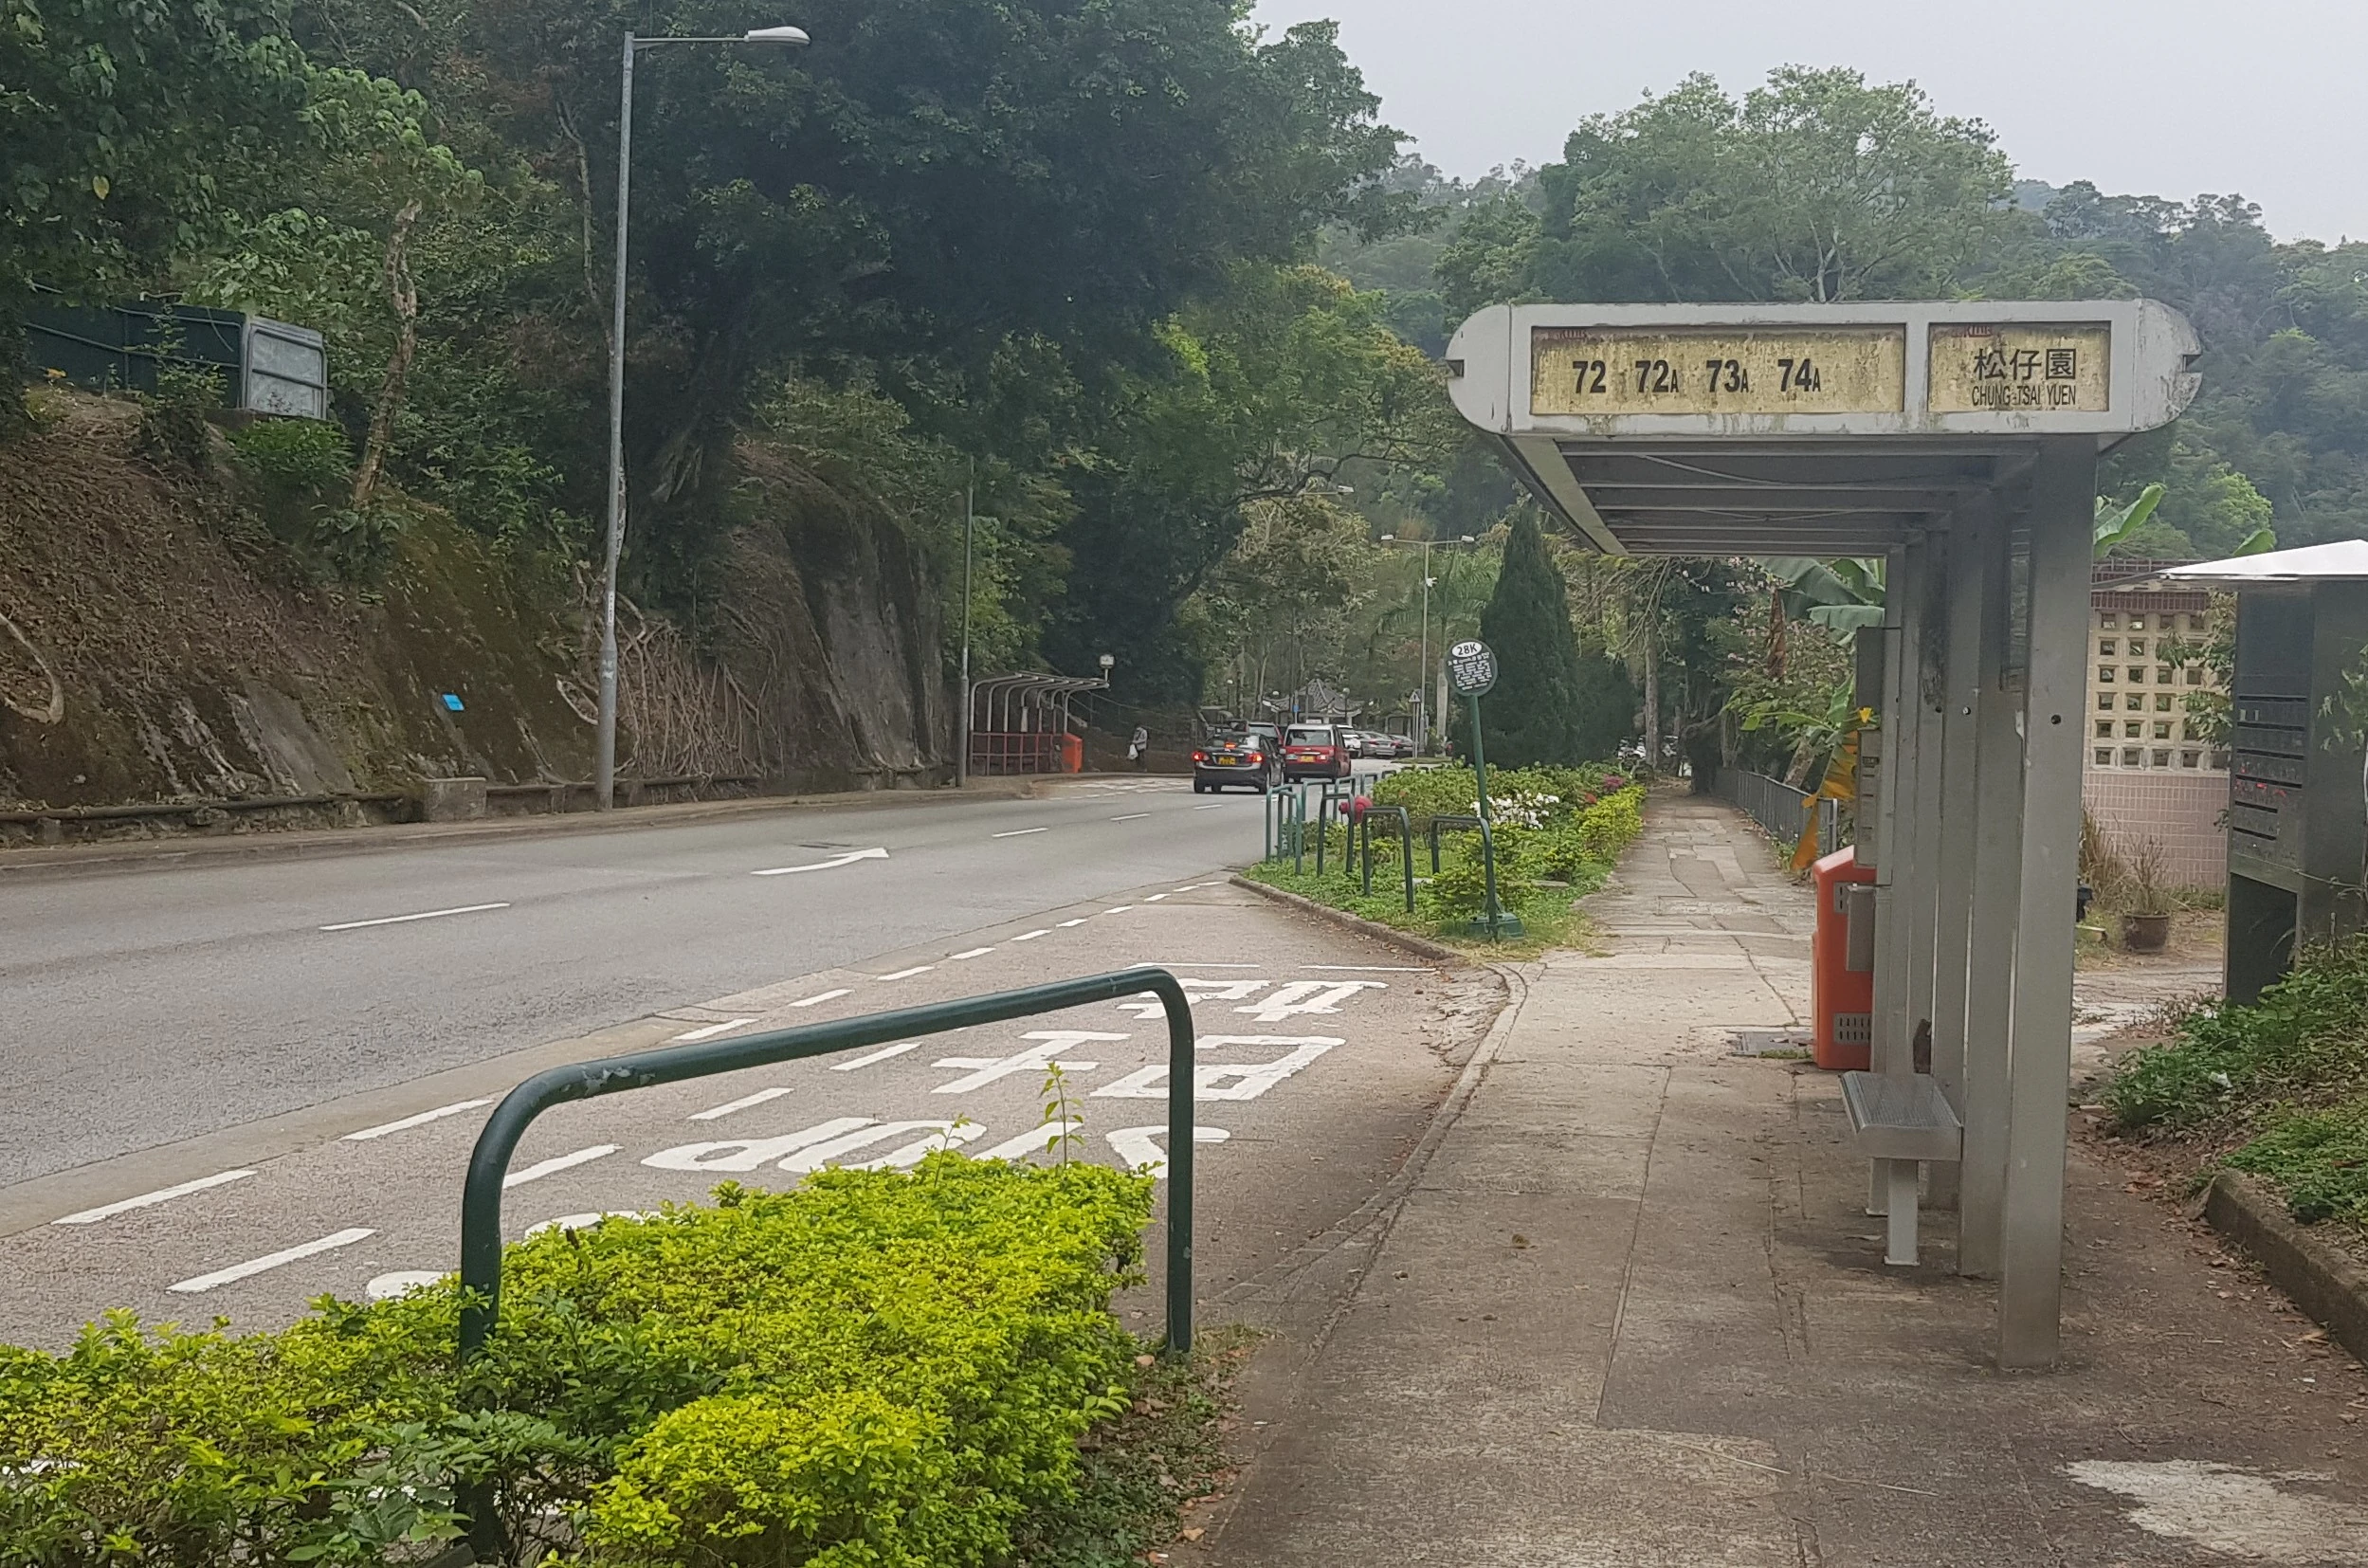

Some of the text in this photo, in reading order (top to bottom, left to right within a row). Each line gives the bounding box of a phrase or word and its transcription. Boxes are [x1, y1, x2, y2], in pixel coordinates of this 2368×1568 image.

[1573, 358, 1821, 393] 72 72A 73A 74A
[1973, 348, 2077, 381] 松仔園
[1972, 384, 2076, 407] CHUNG TSAI YUEN
[1457, 644, 1478, 655] 28K
